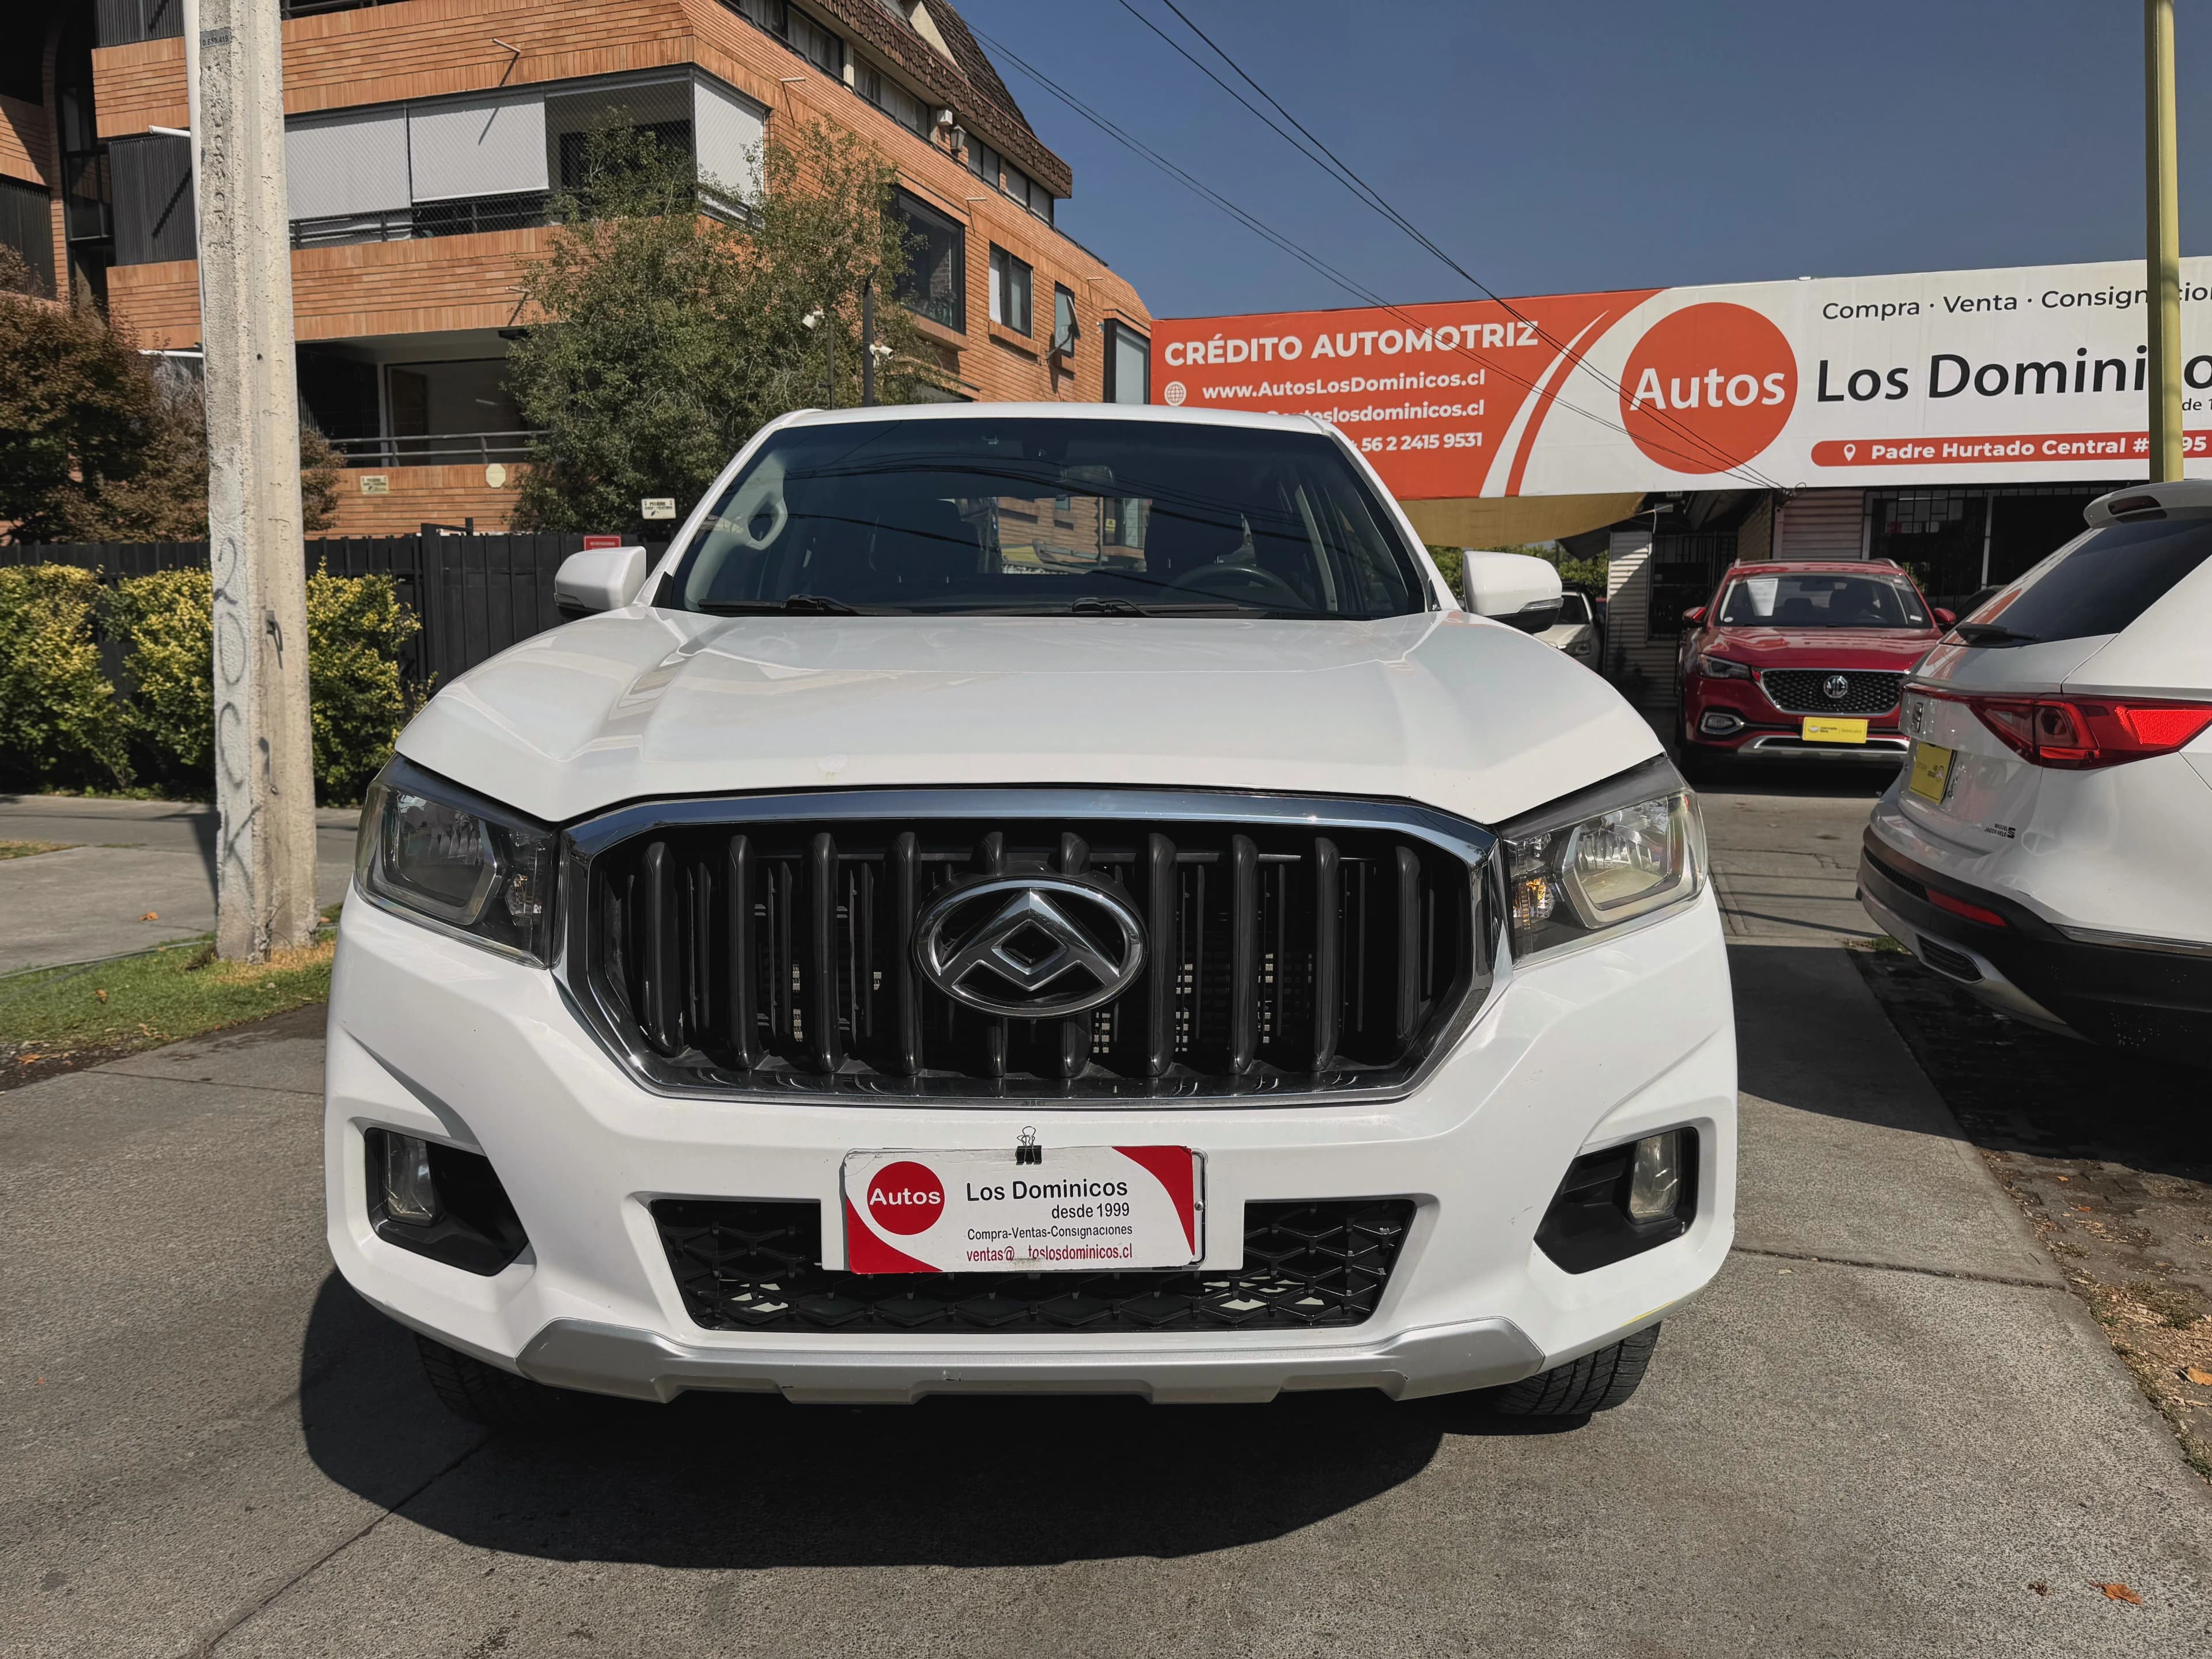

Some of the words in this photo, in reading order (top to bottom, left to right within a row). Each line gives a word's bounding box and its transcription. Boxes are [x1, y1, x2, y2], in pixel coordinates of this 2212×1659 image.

[1823, 302, 1919, 321] Compra
[1943, 294, 2017, 313] Venta
[2041, 282, 2212, 309] Consignio
[1165, 334, 1302, 366] CRÉDITO
[1311, 320, 1539, 359] AUTOMOTRIZ
[1203, 369, 1485, 399] www.AutosLosDominicos.cl
[1817, 359, 1908, 403] Los
[1929, 345, 2212, 398] Dominio
[1630, 368, 1786, 412] Autos
[1361, 437, 1383, 452] 56
[1386, 437, 1397, 451] 2
[1400, 434, 1440, 450] 2415
[1443, 431, 1483, 448] 9531
[1870, 442, 1936, 461] Padre
[1942, 440, 2036, 459] Hurtado
[2041, 437, 2126, 455] Central
[2133, 436, 2207, 453] #95
[869, 1187, 941, 1206] Autos
[967, 1183, 1005, 1202] Los
[1012, 1178, 1128, 1199] Dominicos
[1051, 1204, 1093, 1219] desde
[1096, 1202, 1130, 1217] 1999
[967, 1225, 1132, 1242] Compra-Ventas-Consignaciones
